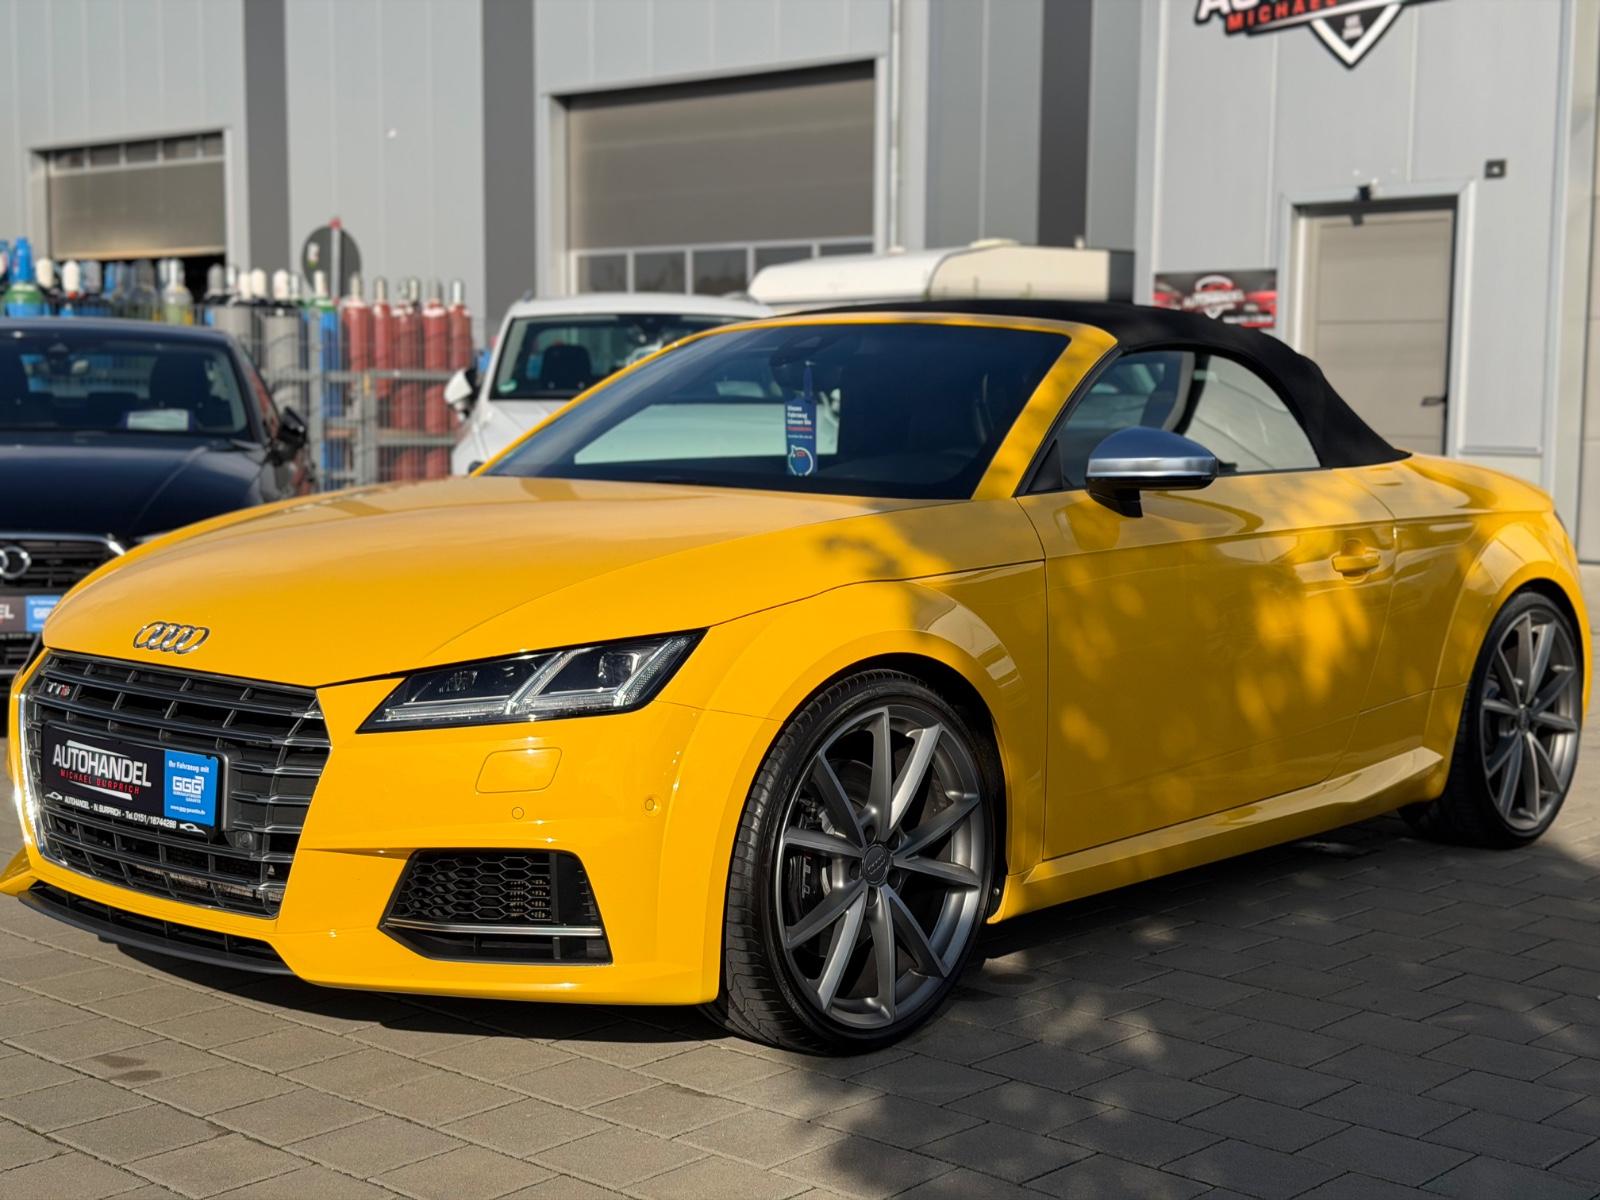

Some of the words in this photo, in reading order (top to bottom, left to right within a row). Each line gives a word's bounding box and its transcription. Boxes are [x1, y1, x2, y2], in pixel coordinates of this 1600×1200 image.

[52, 744, 152, 787] AUTOHANDEL
[60, 768, 92, 785] MICHAEL
[173, 776, 202, 795] GGG
